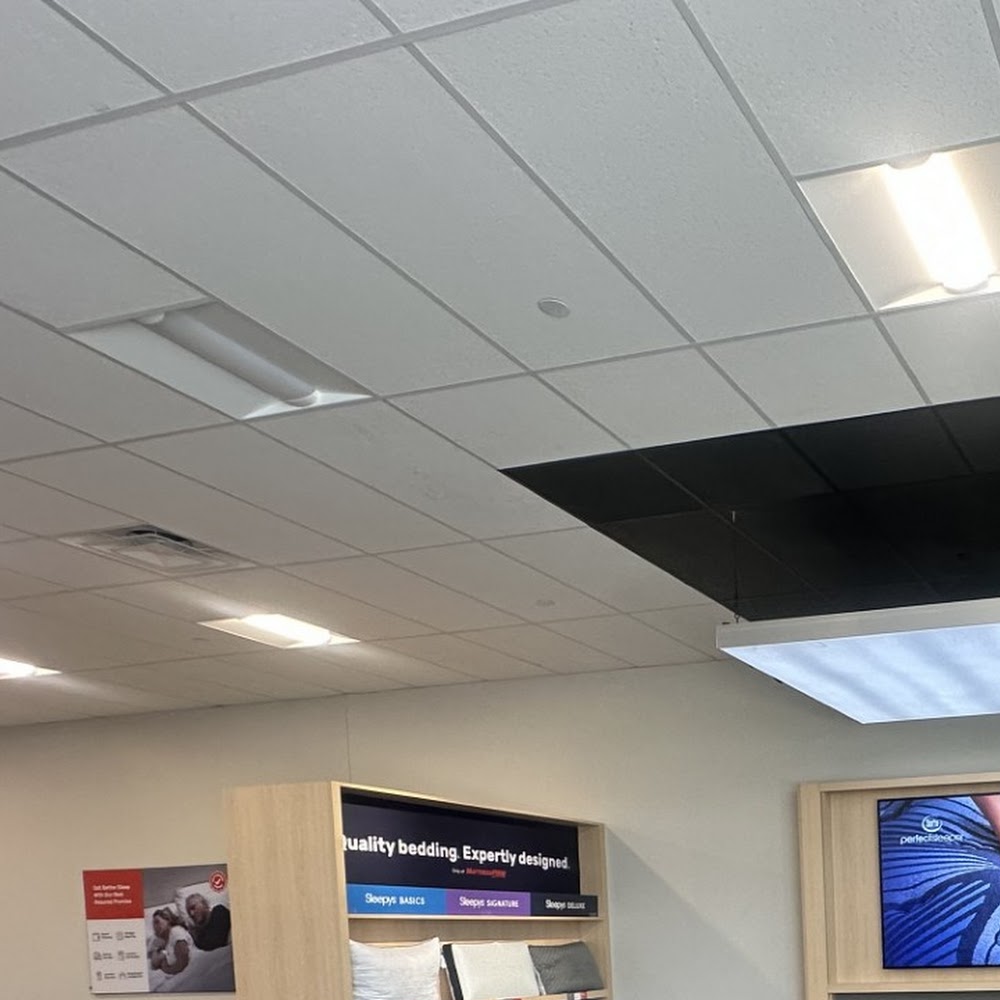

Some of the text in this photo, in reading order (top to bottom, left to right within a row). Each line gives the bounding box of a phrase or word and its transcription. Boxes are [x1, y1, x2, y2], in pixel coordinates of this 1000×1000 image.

[398, 839, 461, 862] bedding.
[463, 845, 517, 867] Expertly
[519, 851, 571, 870] designed.
